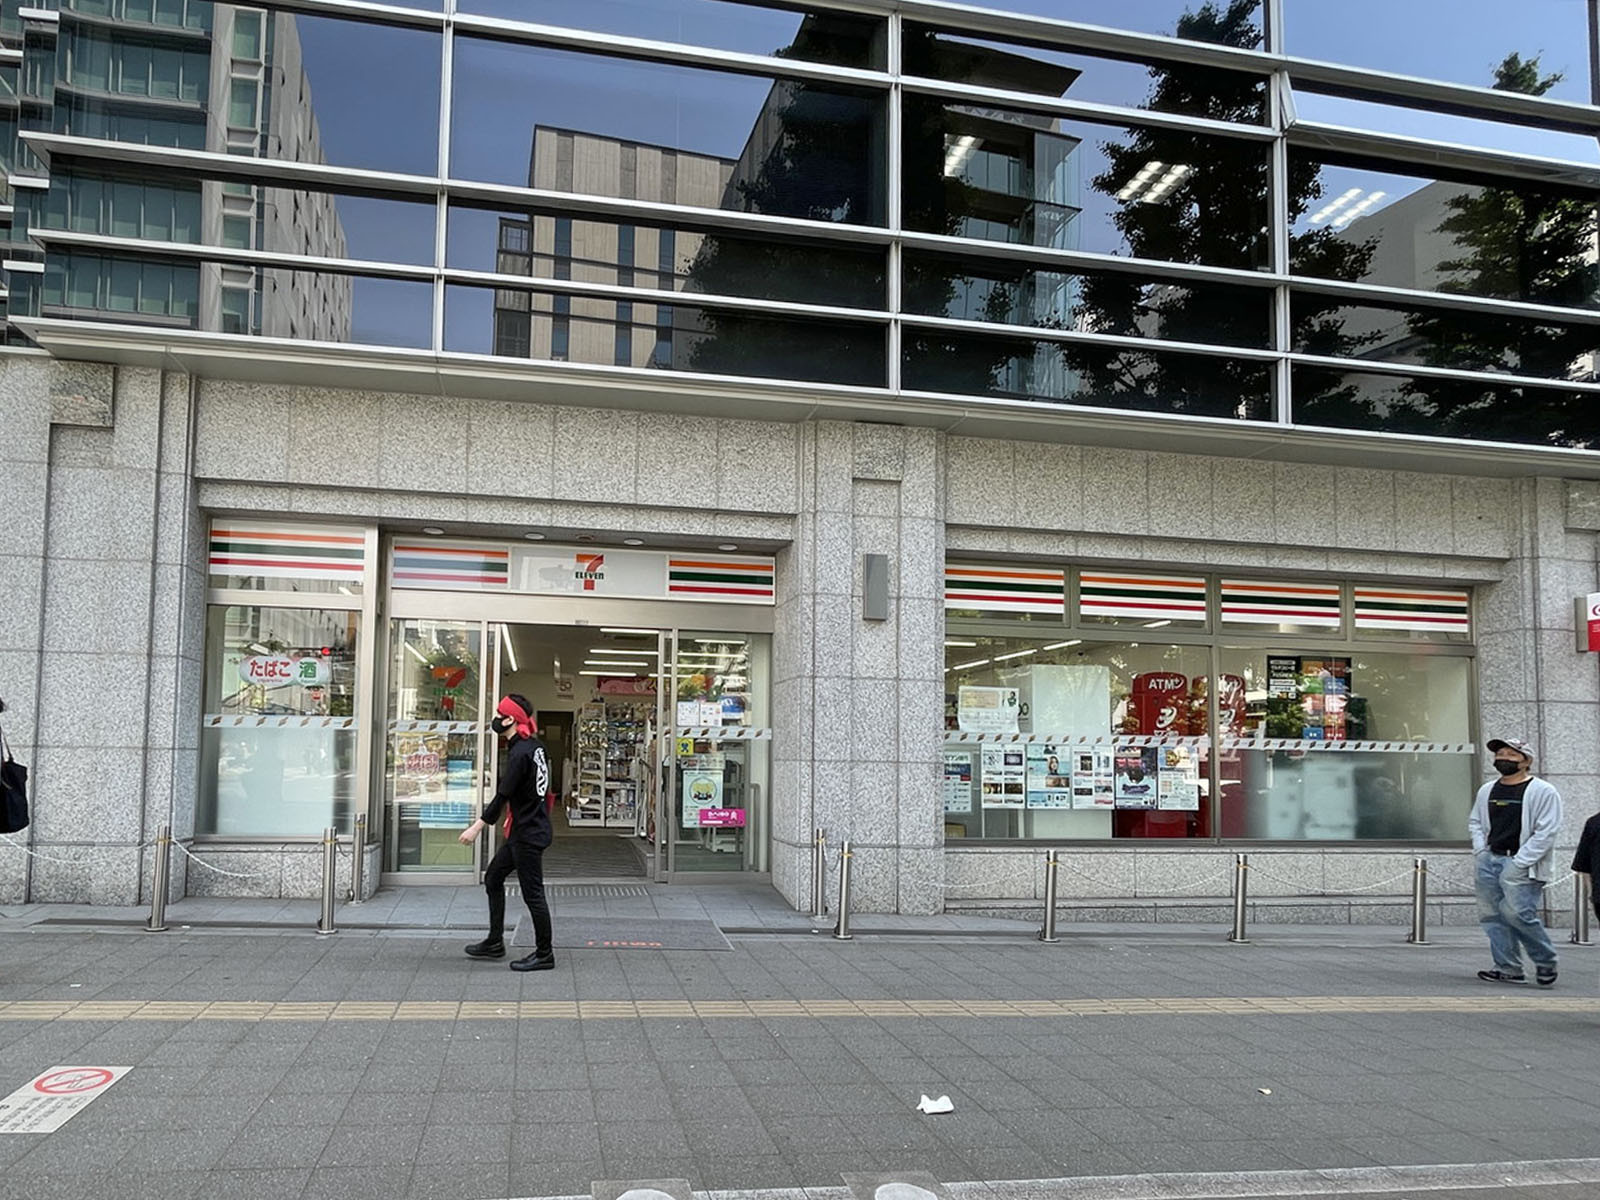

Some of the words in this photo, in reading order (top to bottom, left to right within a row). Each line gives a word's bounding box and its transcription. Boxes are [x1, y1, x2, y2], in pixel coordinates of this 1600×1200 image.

[249, 660, 291, 677] たばこ
[299, 661, 317, 678] 酒
